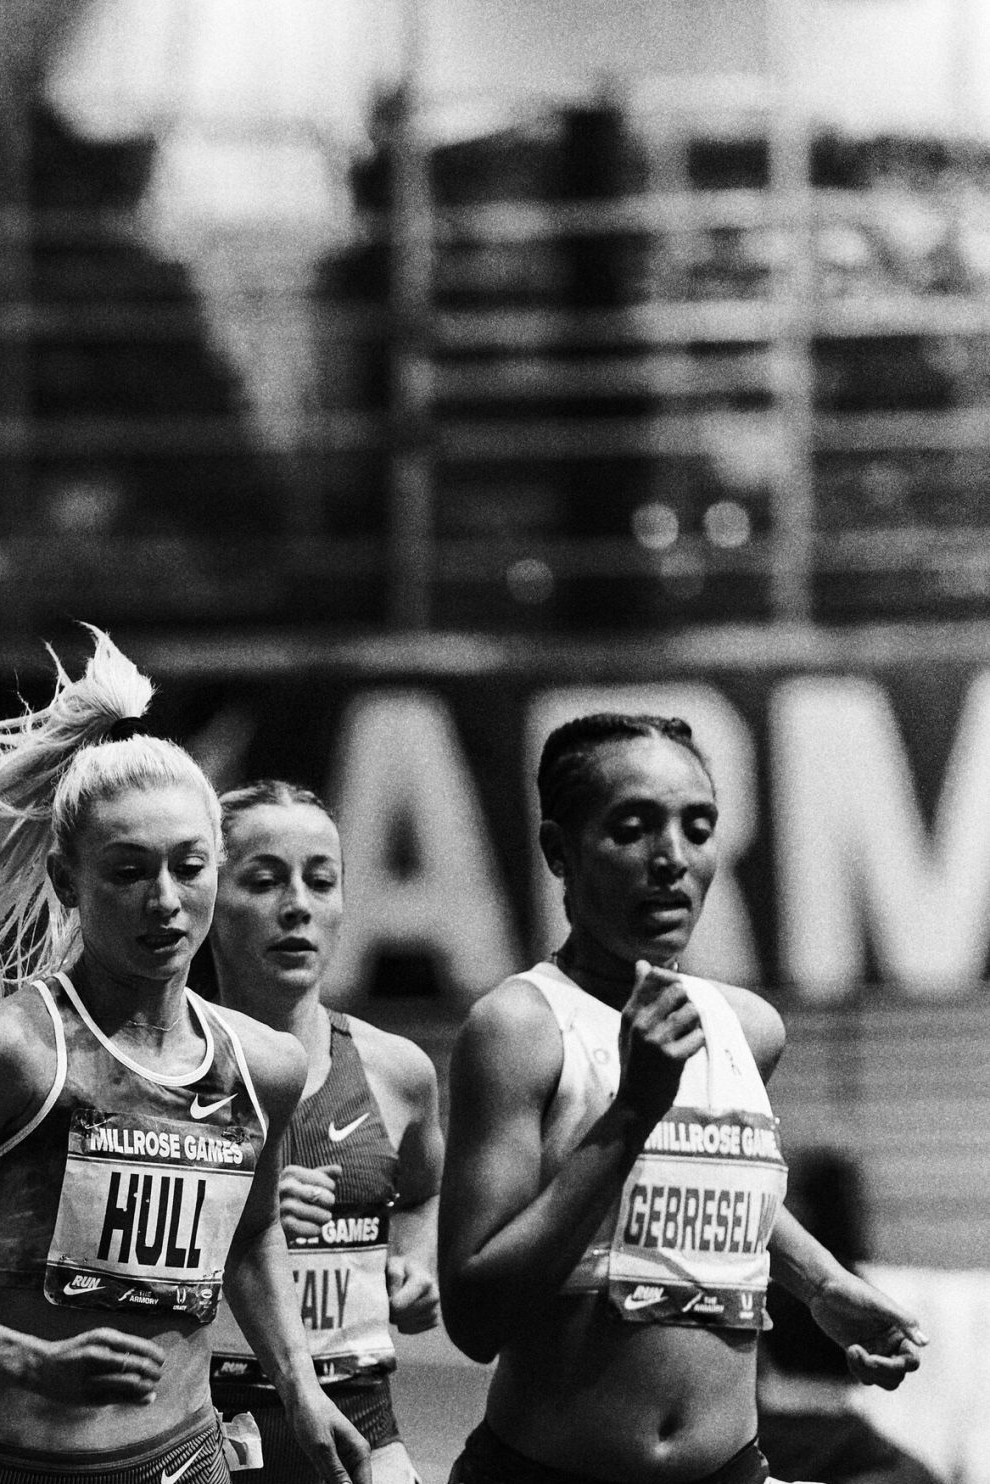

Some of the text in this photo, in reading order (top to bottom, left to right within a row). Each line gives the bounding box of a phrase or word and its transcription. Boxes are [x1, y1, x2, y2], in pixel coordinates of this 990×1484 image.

[90, 1128, 243, 1164] MILLROSE GAMES
[644, 1121, 741, 1155] MILLROSE
[97, 1171, 206, 1269] HULL
[322, 1217, 379, 1244] GAMES
[72, 1275, 101, 1288] RUN
[293, 1269, 350, 1330] ALY
